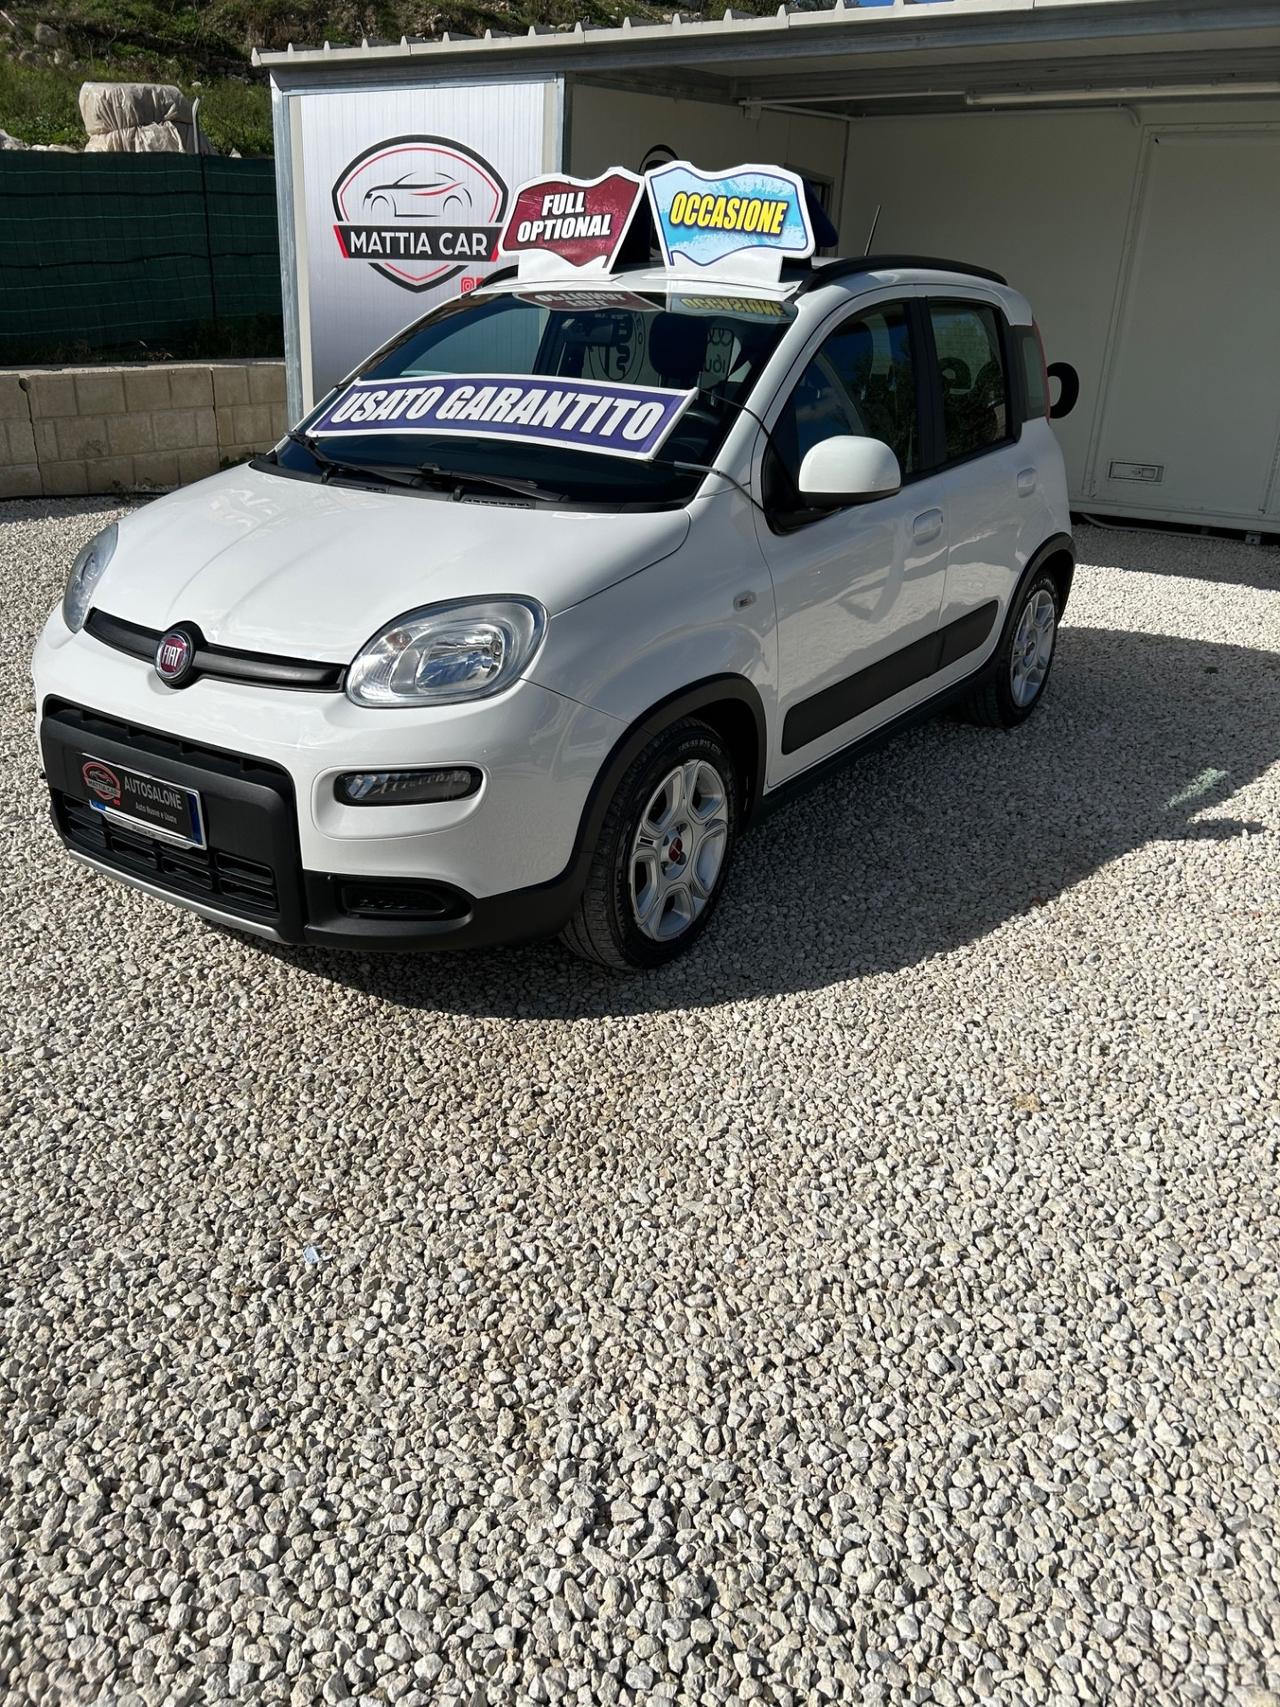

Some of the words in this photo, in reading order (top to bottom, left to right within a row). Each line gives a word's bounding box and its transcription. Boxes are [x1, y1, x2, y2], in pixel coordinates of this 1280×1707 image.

[541, 191, 586, 216] FULL
[669, 192, 788, 235] OCCASIONE
[517, 214, 611, 242] OPTIONAL
[350, 231, 432, 255] MATTIA
[439, 232, 488, 256] CAR
[330, 386, 445, 424] USATO
[435, 385, 666, 441] GARANTITO
[161, 644, 183, 667] FIAT
[124, 775, 183, 810] AUTOSALONE
